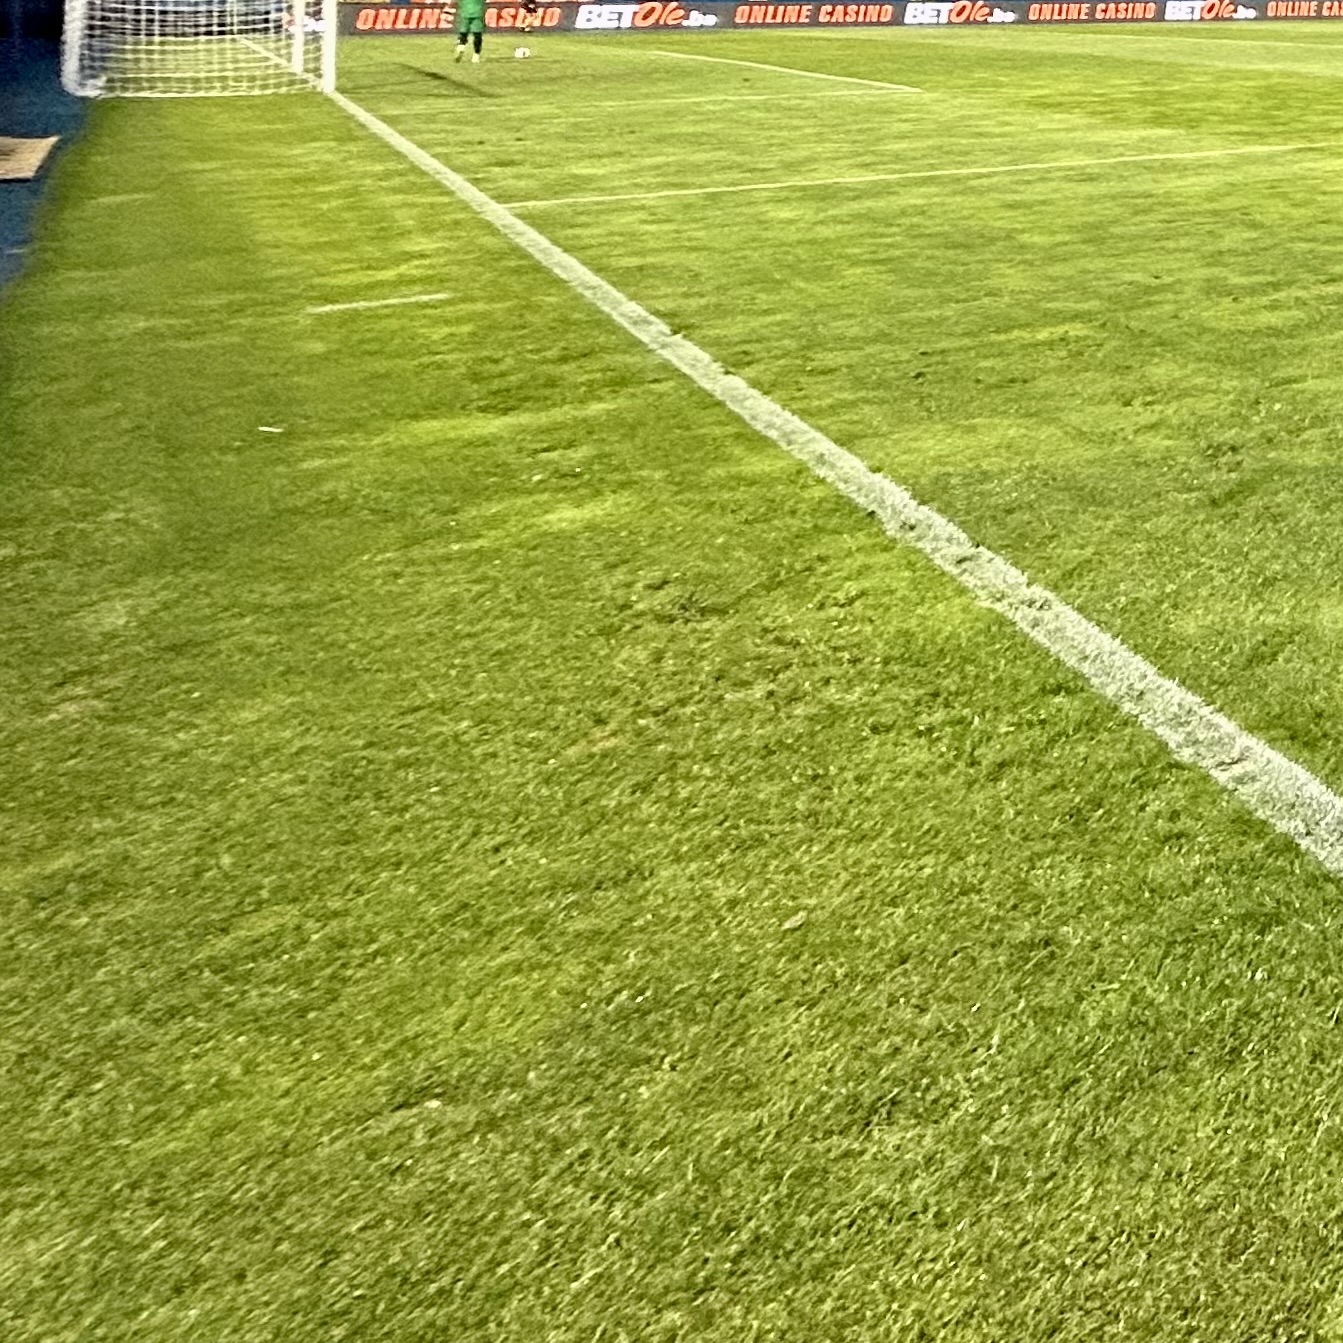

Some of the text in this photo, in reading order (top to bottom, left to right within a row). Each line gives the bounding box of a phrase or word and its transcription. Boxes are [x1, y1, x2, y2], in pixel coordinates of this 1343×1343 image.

[355, 8, 455, 30] ONLINE
[735, 5, 812, 24] ONLINE
[818, 4, 894, 23] CASINO
[1028, 3, 1090, 21] ONLINE
[1095, 2, 1157, 20] CASINO
[1266, 1, 1318, 17] ONLINE
